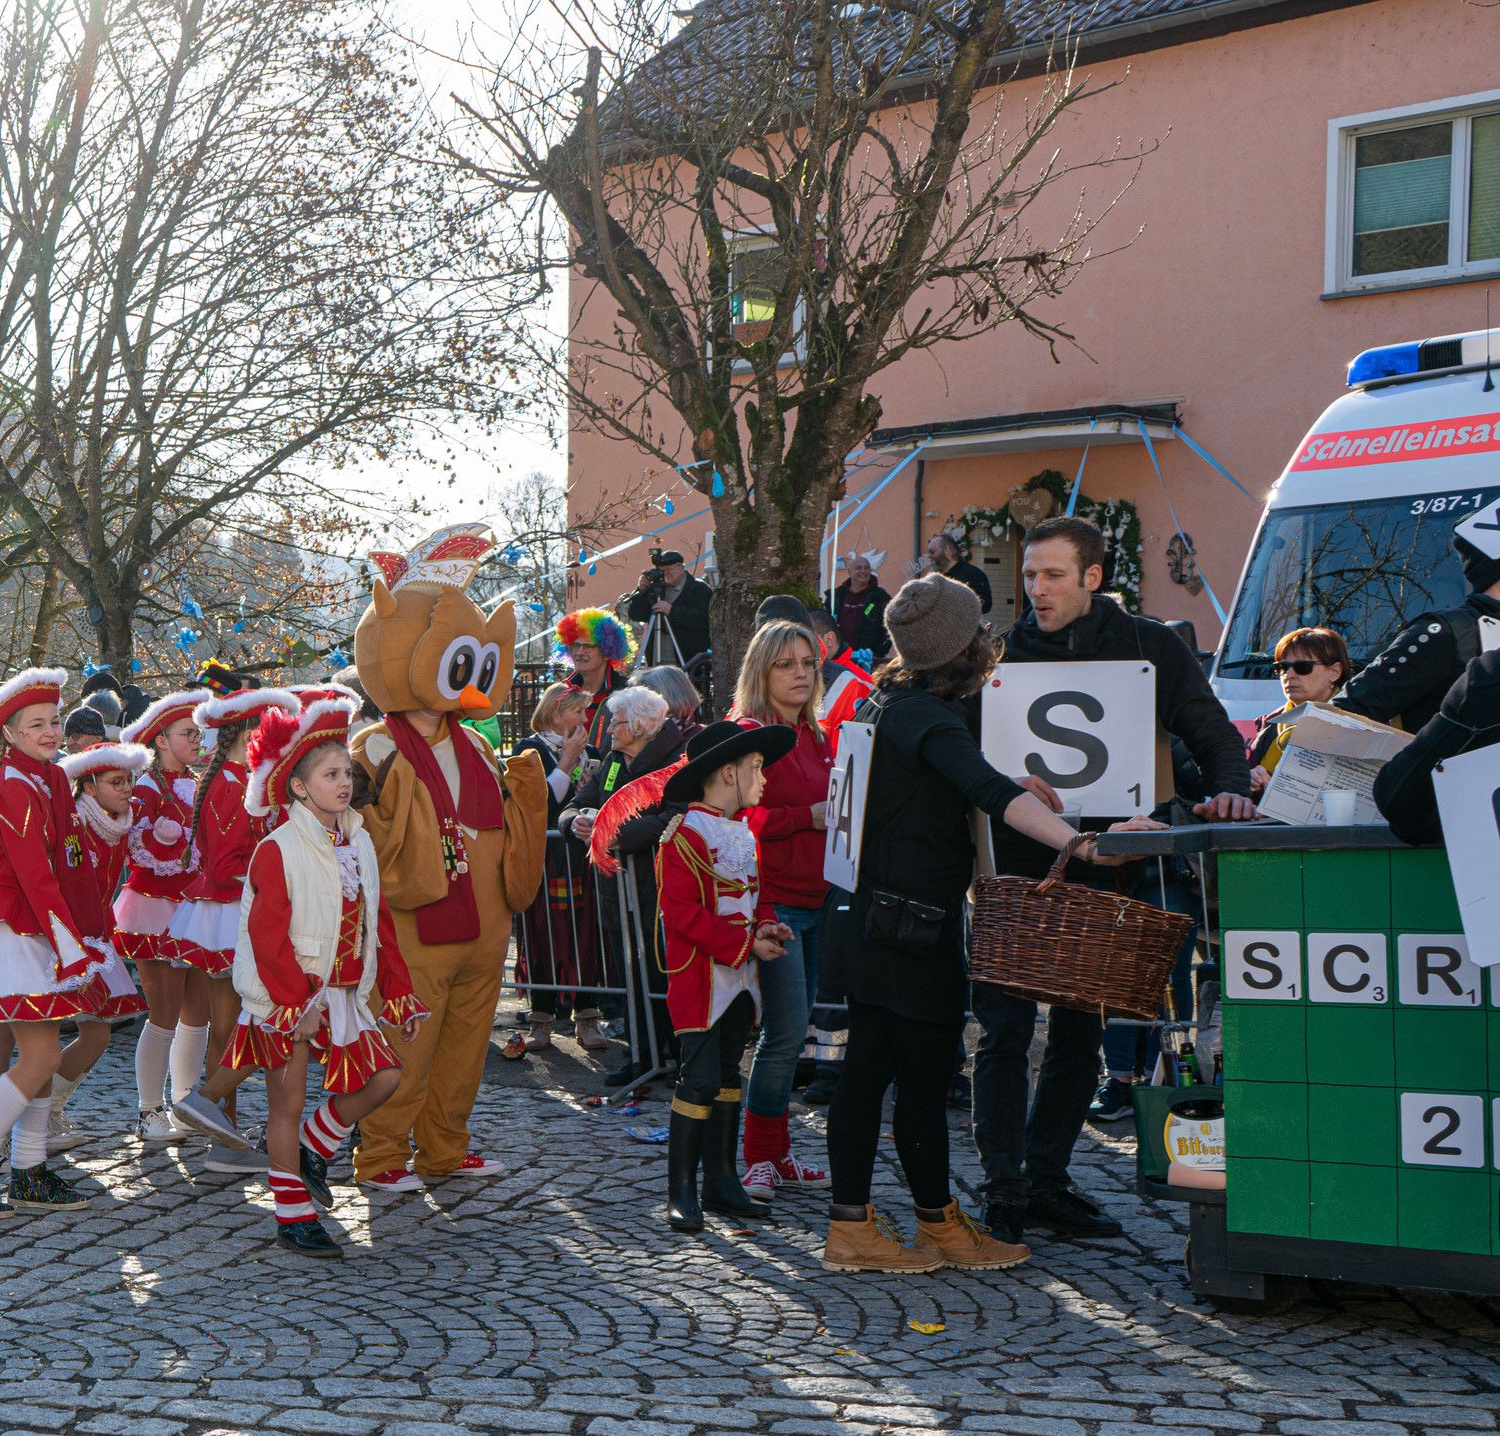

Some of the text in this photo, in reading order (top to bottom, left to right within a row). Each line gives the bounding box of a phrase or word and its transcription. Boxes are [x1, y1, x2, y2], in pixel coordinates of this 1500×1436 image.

[1011, 497, 1040, 510] YOU &
[1022, 514, 1036, 523] ME
[1410, 493, 1483, 515] 3/87-1
[1024, 690, 1141, 808] S 1
[827, 778, 838, 819] R
[832, 753, 854, 861] A
[1242, 941, 1476, 1004] S 1 C 3 R 1
[1422, 1105, 1462, 1155] 2
